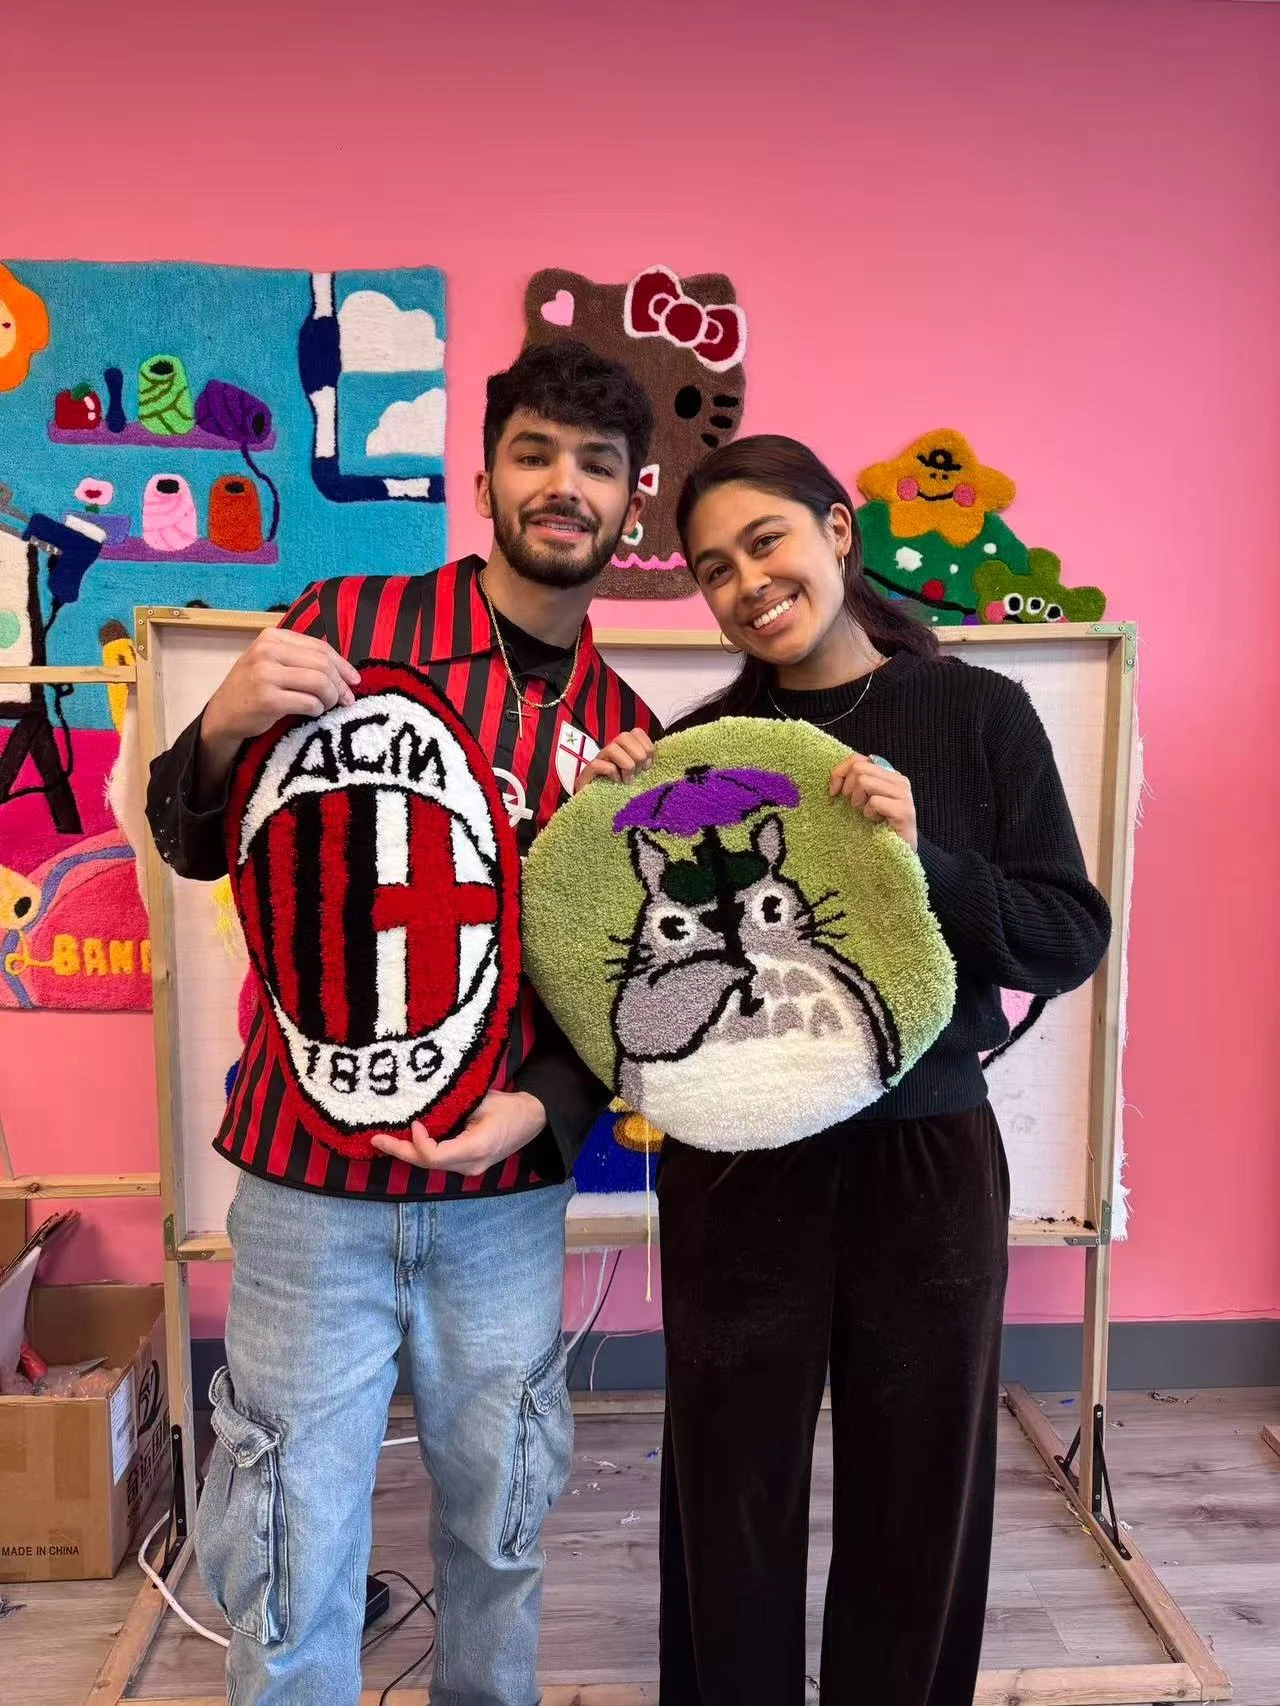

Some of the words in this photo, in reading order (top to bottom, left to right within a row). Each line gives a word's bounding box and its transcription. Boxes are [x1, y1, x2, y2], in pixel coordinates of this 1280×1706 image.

[278, 713, 446, 798] ACM
[303, 1040, 445, 1096] 1899
[1, 1546, 33, 1556] MADE
[36, 1546, 46, 1556] IN
[49, 1546, 80, 1556] CHINA
